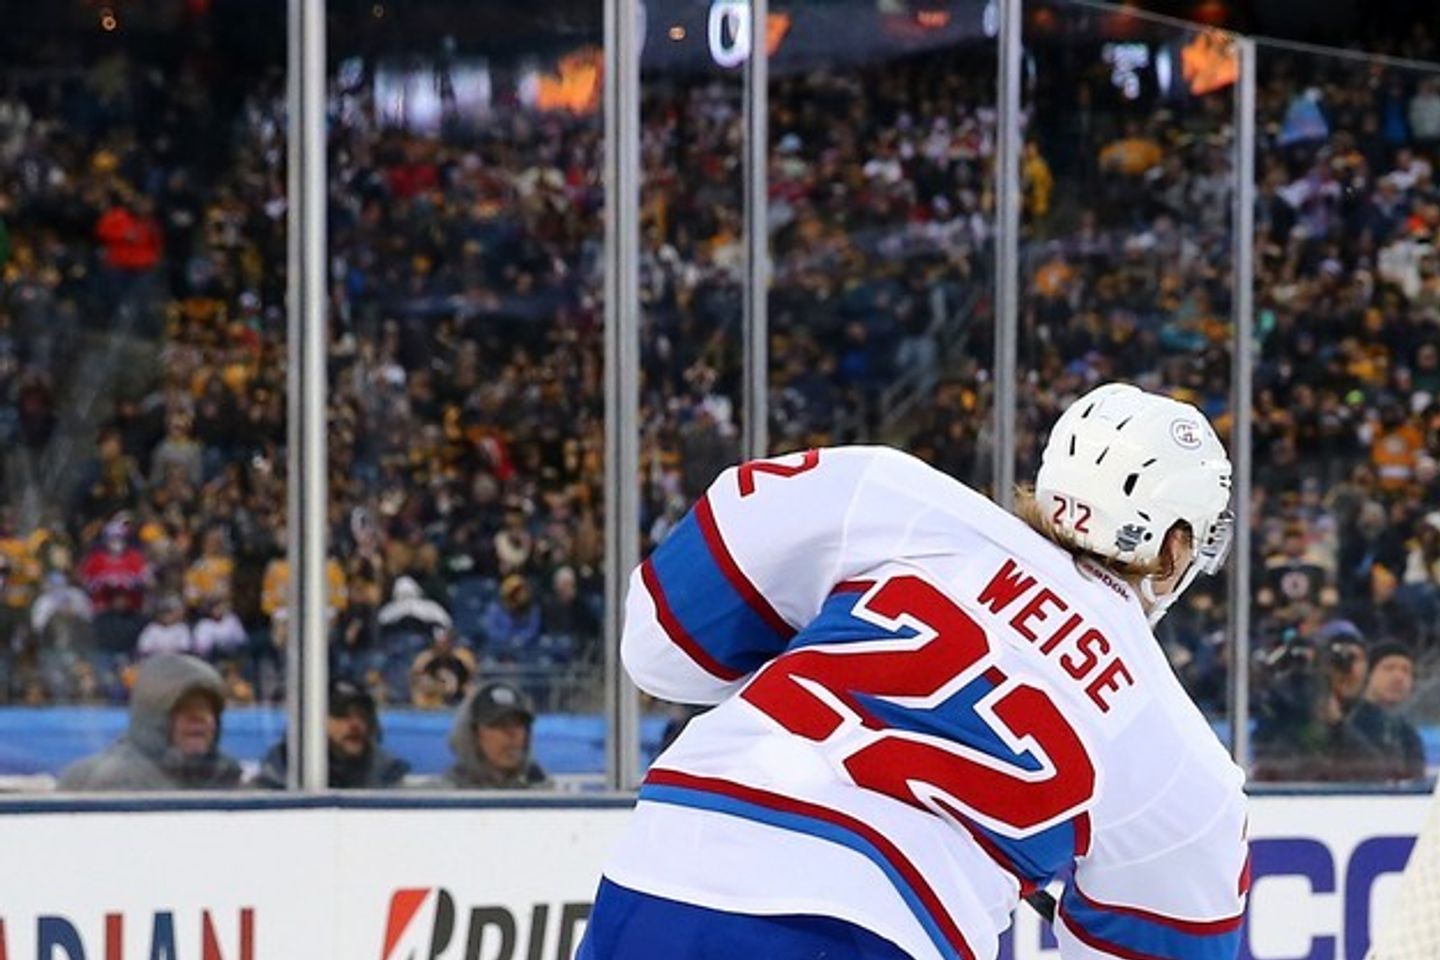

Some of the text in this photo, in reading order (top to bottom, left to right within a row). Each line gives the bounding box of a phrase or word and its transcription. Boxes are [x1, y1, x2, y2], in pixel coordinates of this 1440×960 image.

[1053, 495, 1092, 534] 22
[740, 574, 1097, 830] 22
[977, 558, 1134, 714] WEISE
